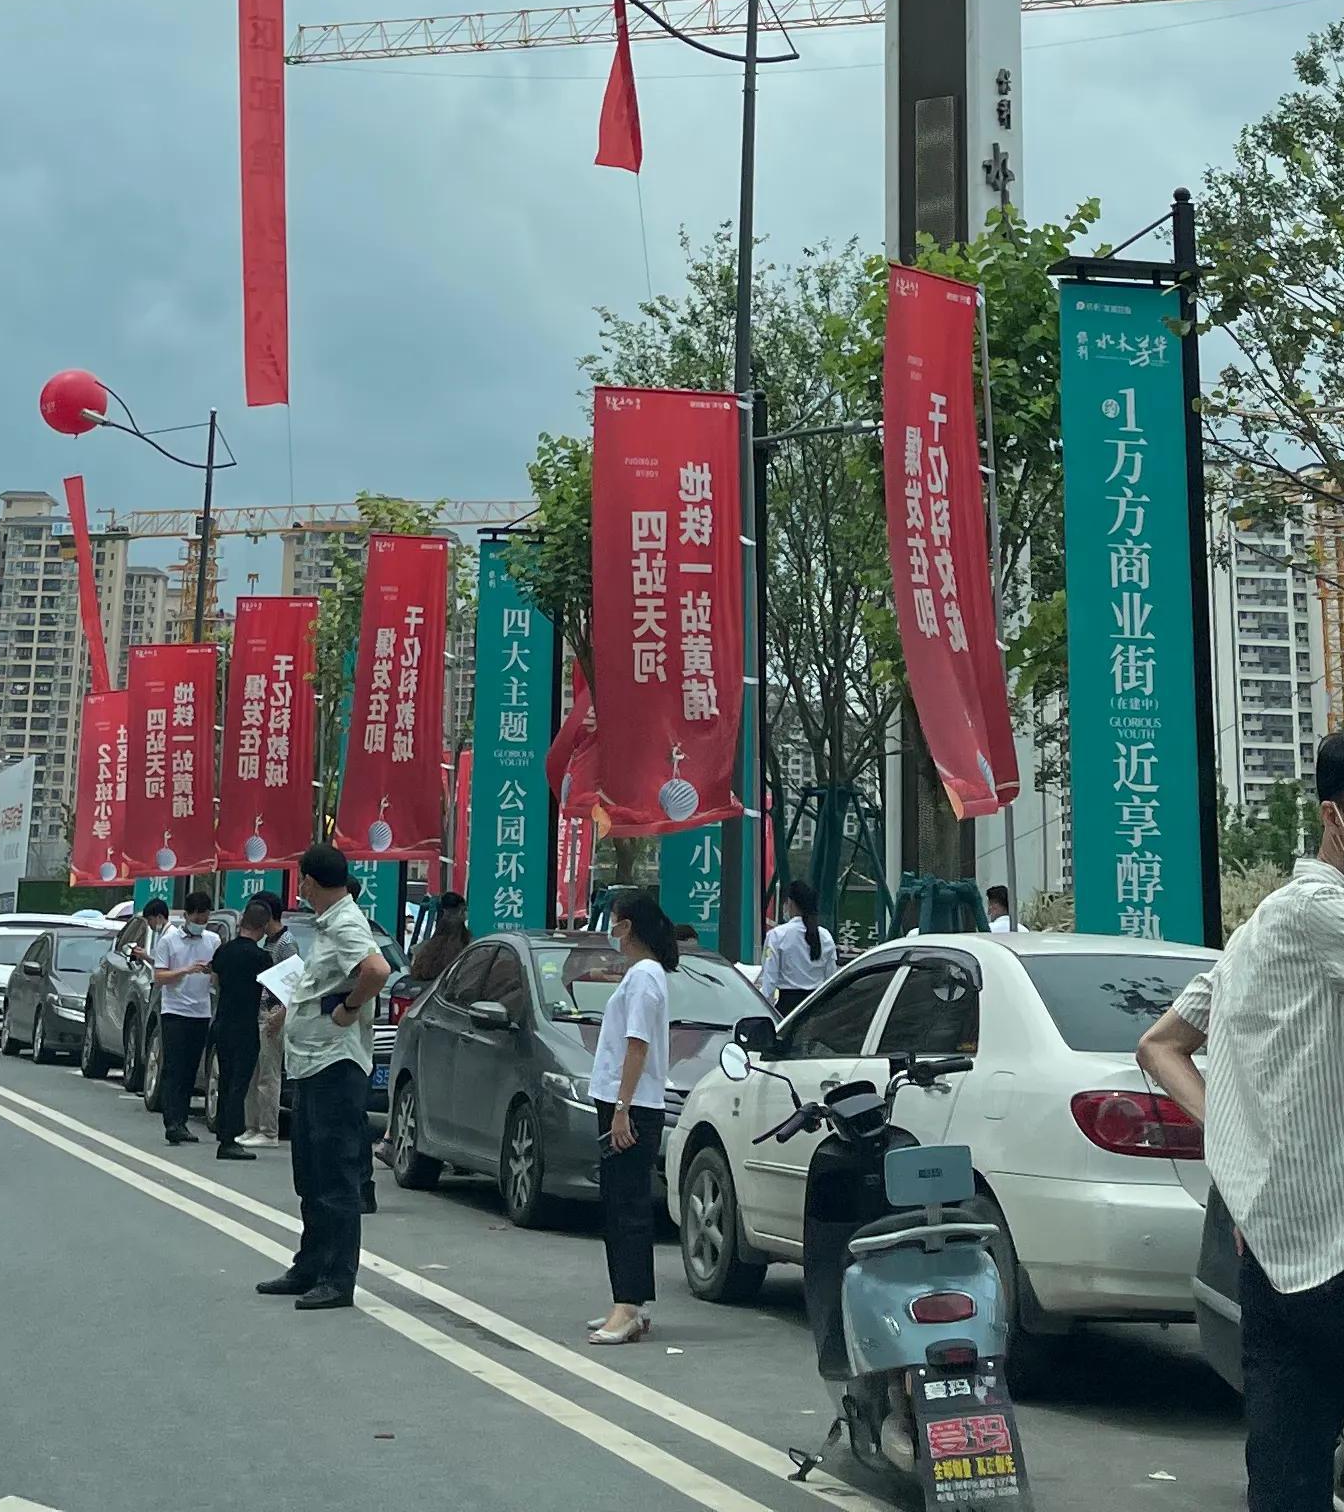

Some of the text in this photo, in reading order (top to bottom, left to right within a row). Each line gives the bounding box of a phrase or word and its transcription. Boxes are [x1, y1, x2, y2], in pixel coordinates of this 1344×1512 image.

[1103, 387, 1156, 695] 1万方商业街
[497, 606, 531, 743] 四大主题
[1109, 716, 1162, 729] GLORIOUS
[1117, 728, 1155, 740] YOUTH
[493, 779, 528, 920] 公园环绕
